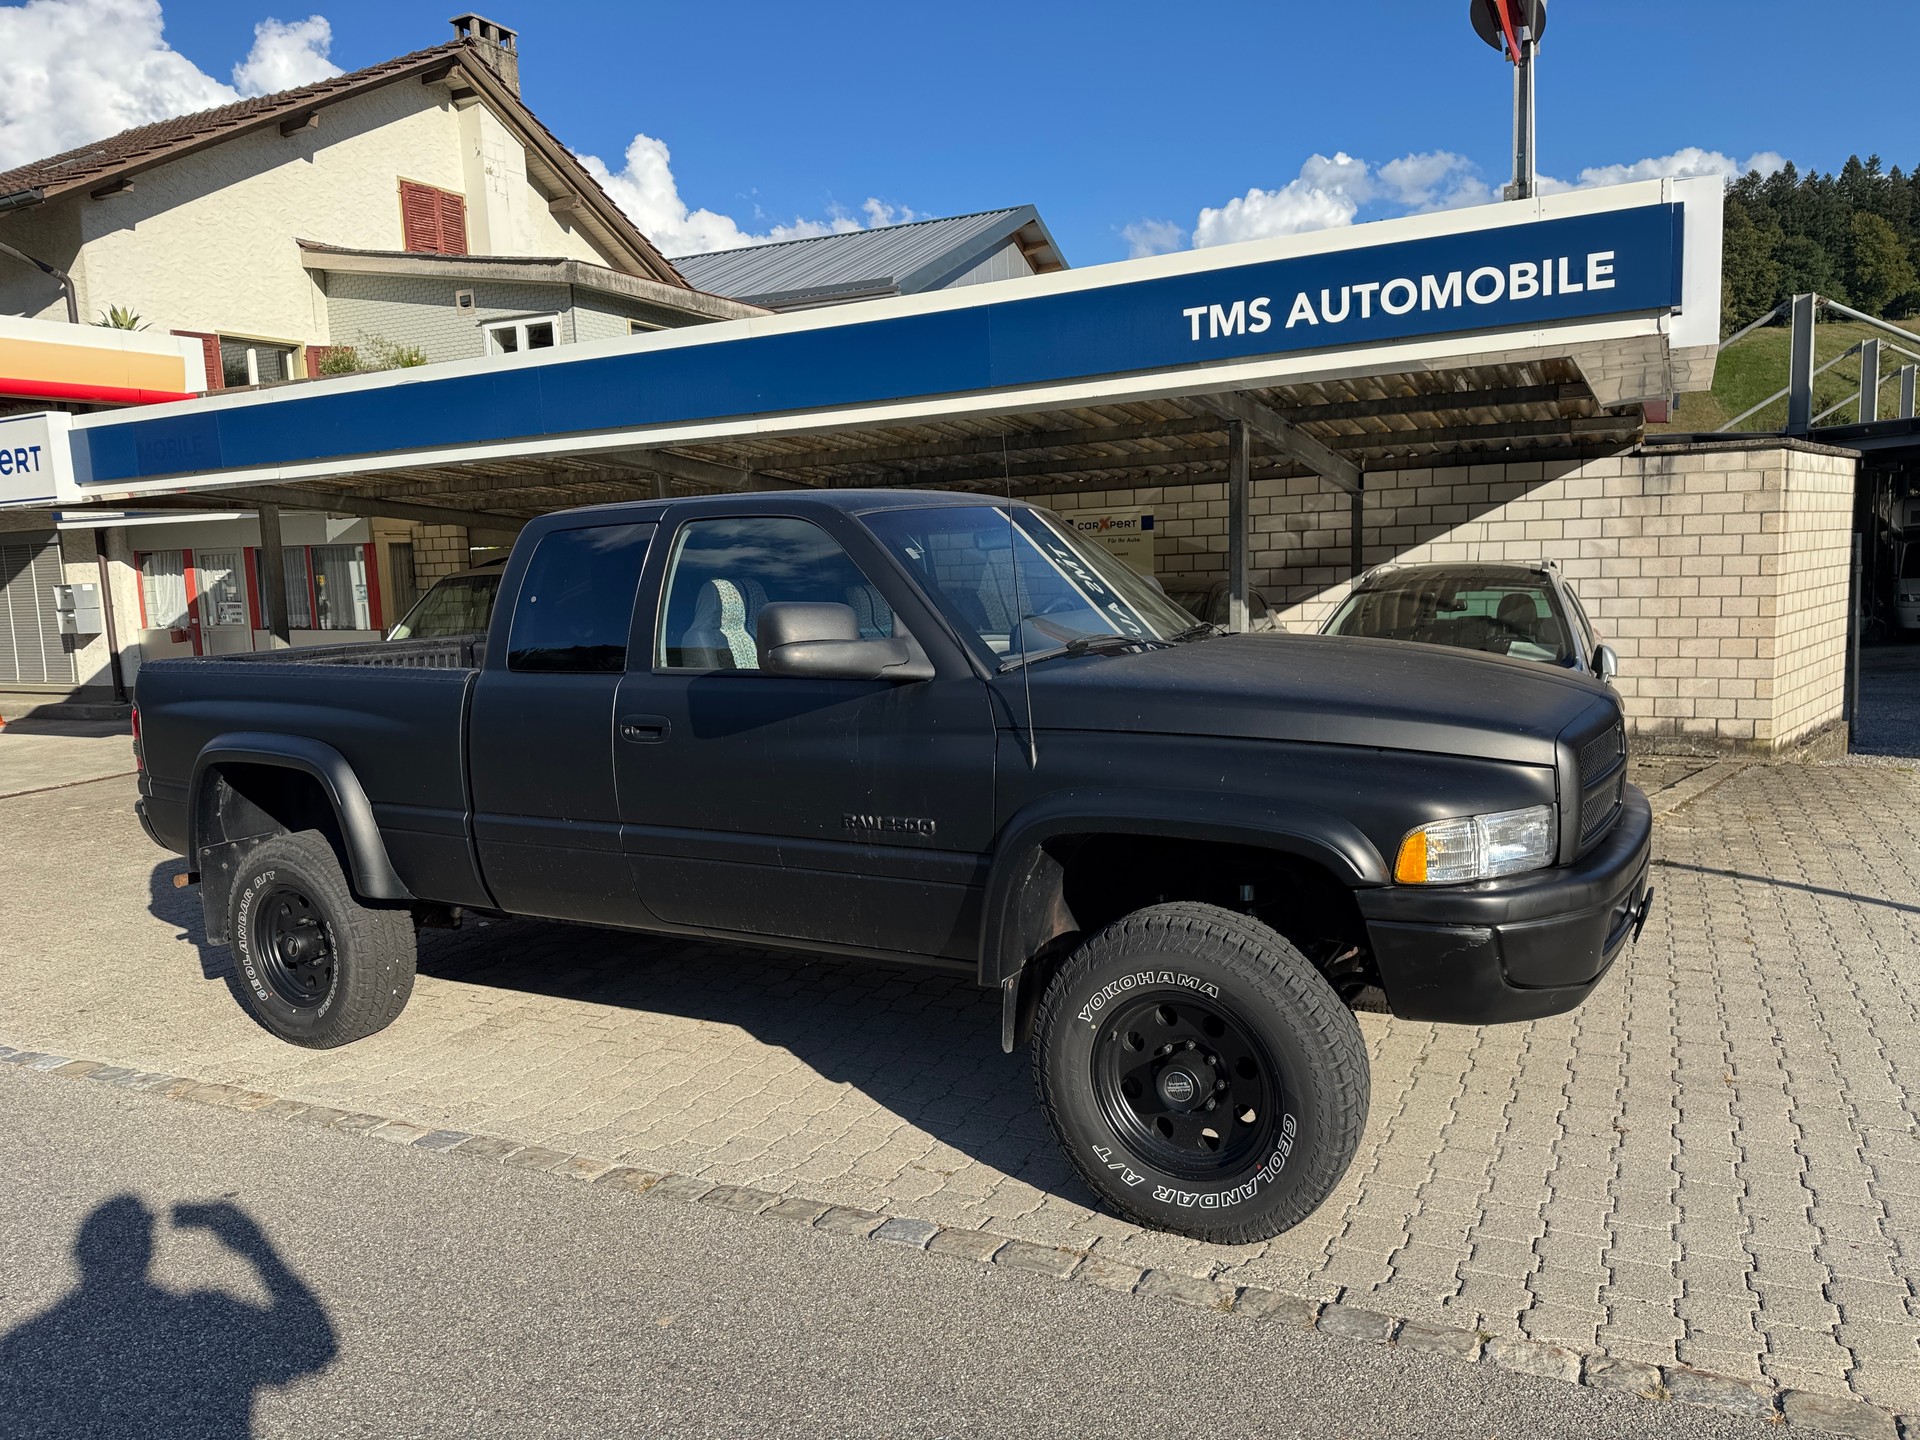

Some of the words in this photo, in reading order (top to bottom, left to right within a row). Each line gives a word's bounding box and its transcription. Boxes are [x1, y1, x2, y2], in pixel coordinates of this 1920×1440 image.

[1183, 297, 1272, 341] TMS
[1285, 250, 1616, 329] AUTOMOBILE
[253, 870, 276, 890] A/T
[237, 887, 270, 1002] GEOLANDAR
[1078, 970, 1220, 1024] YOKOHAMA
[1092, 1143, 1145, 1188] A/T
[1153, 1112, 1297, 1209] GEOLANDAR
